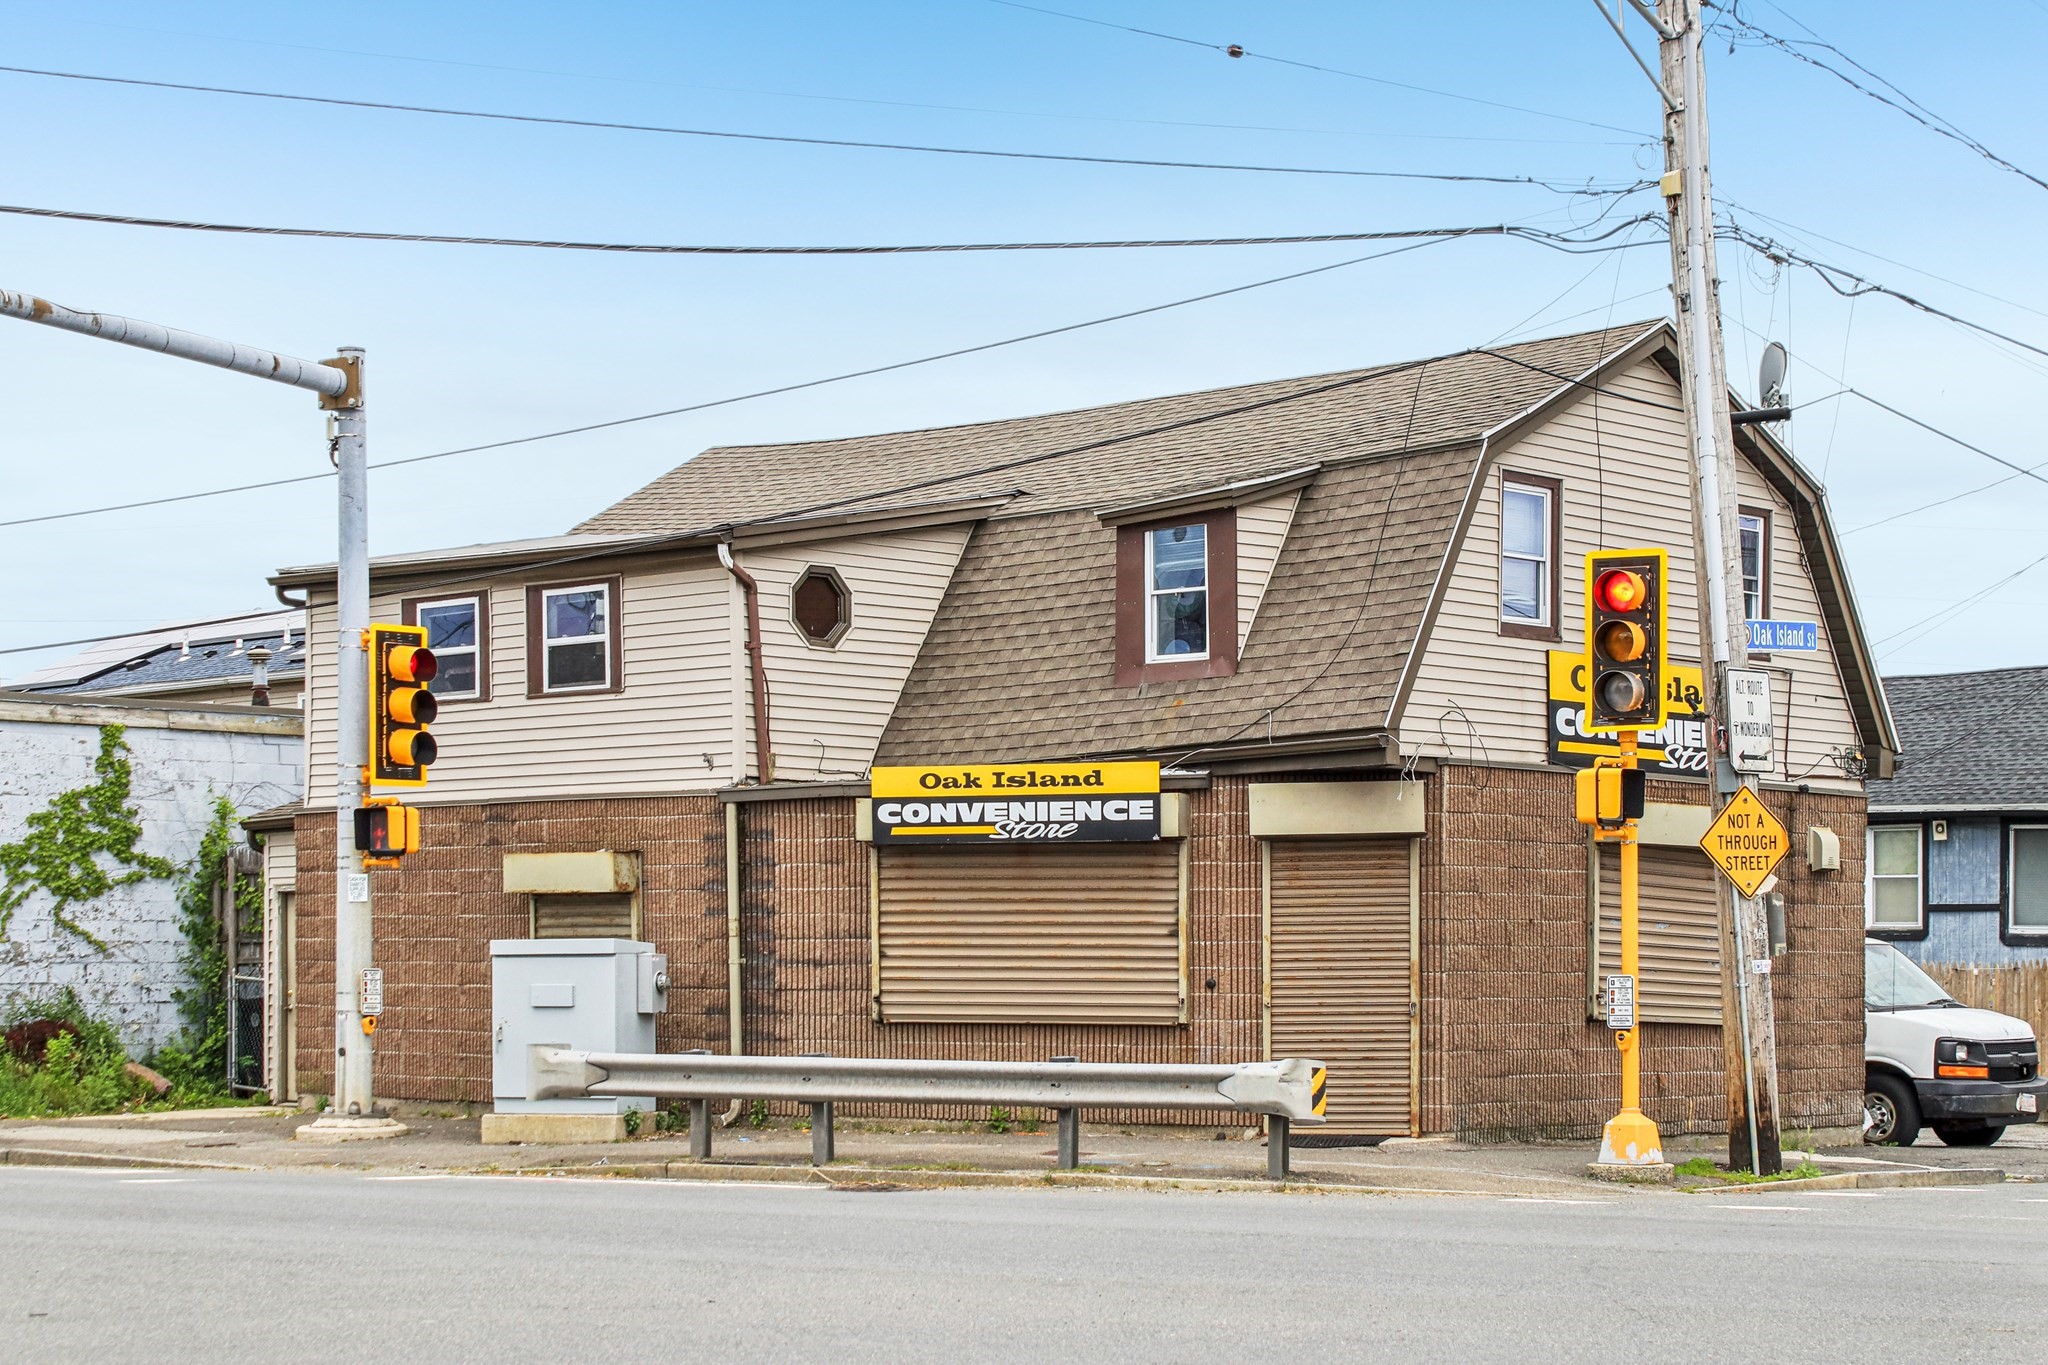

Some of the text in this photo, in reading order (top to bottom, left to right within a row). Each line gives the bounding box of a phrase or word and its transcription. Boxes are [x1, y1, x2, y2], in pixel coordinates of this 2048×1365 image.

[1753, 622, 1815, 648] Oak Island St
[1747, 680, 1763, 696] ROUTE
[1747, 700, 1754, 716] TO
[1740, 721, 1771, 738] WONDERLAND
[1659, 743, 1710, 771] Sto
[919, 769, 1104, 790] Oak Island
[877, 799, 1154, 824] CONVENIENCE
[989, 819, 1079, 839] Store
[1727, 813, 1764, 828] NOT A
[1717, 835, 1777, 850] THROUGH
[1726, 855, 1770, 871] STREET
